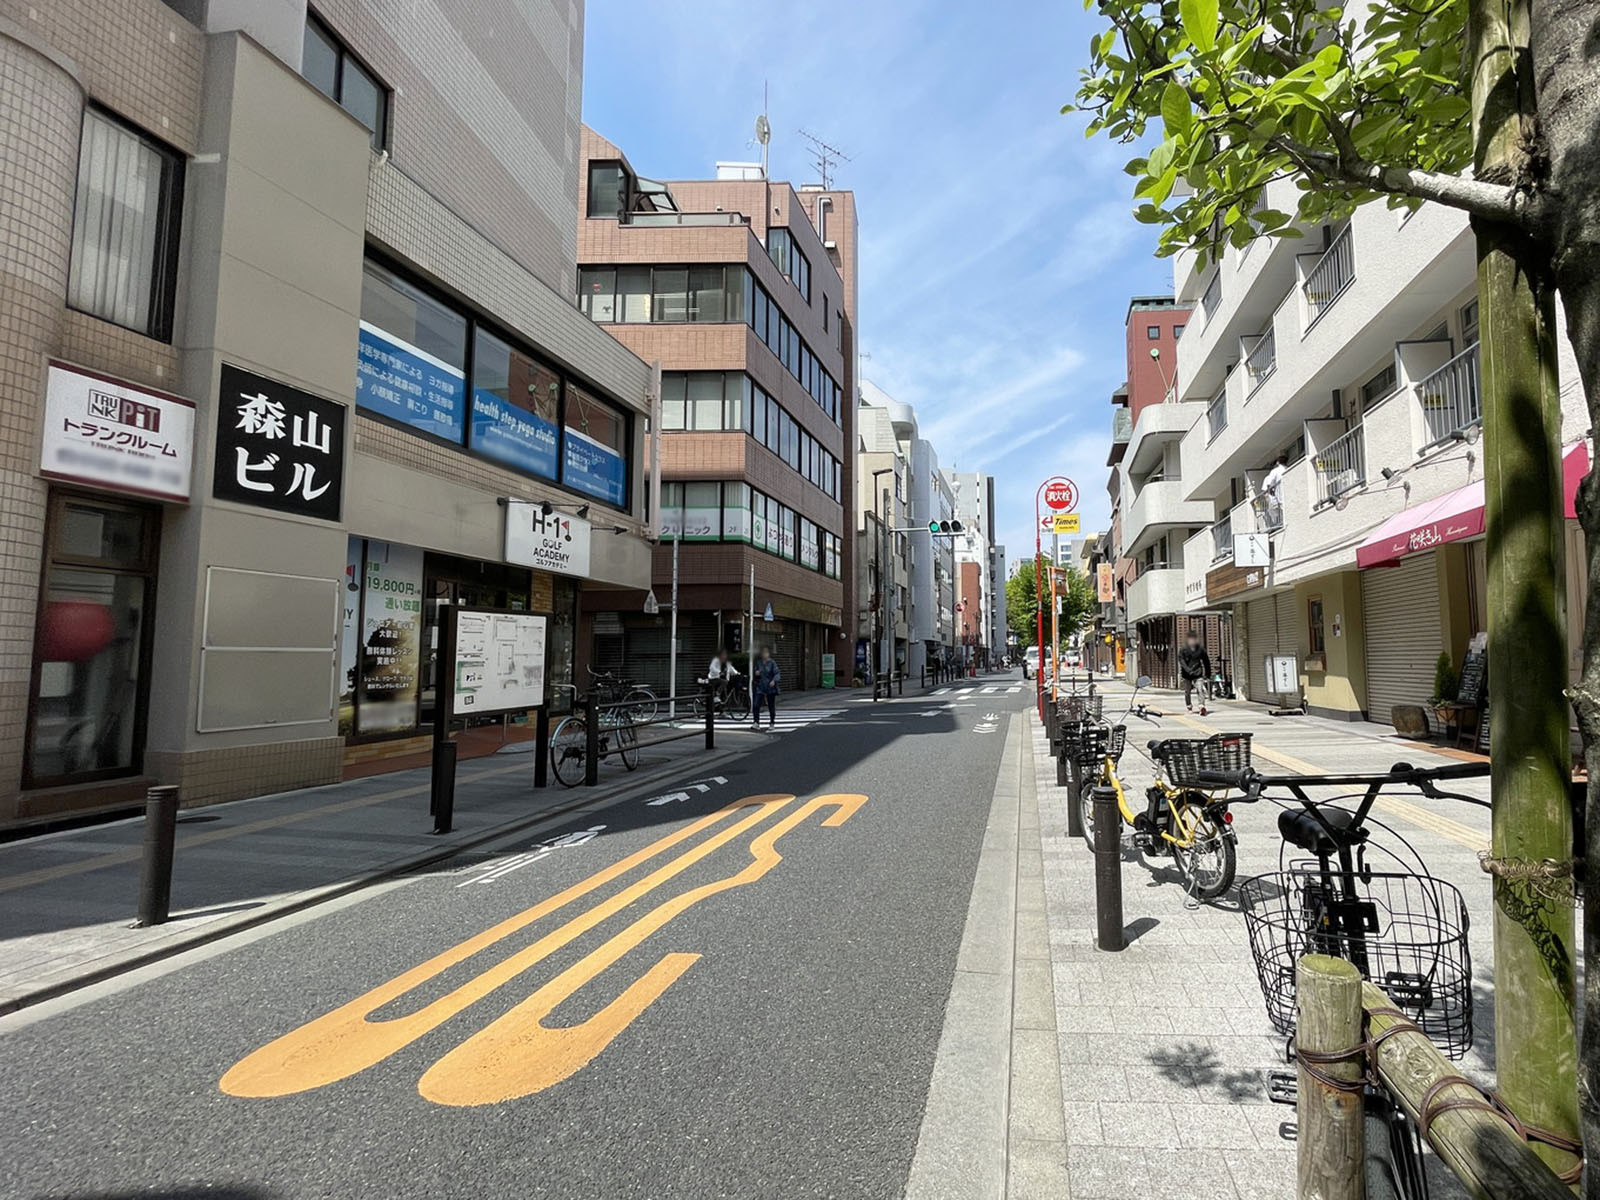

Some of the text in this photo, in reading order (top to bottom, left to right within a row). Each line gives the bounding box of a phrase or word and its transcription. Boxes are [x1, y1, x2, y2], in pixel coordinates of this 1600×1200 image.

[235, 392, 332, 454] 森山
[474, 394, 500, 420] health
[500, 412, 517, 431] step
[517, 420, 535, 438] yoga
[535, 428, 556, 445] studio
[64, 418, 178, 457] トランクルーム
[235, 447, 332, 501] ビル
[1047, 491, 1071, 502] 消火栓
[532, 510, 560, 538] H-1
[1055, 518, 1078, 526] Times
[533, 547, 570, 563] ACADEMY
[542, 538, 562, 551] GOLF
[385, 597, 420, 613] 通い放題
